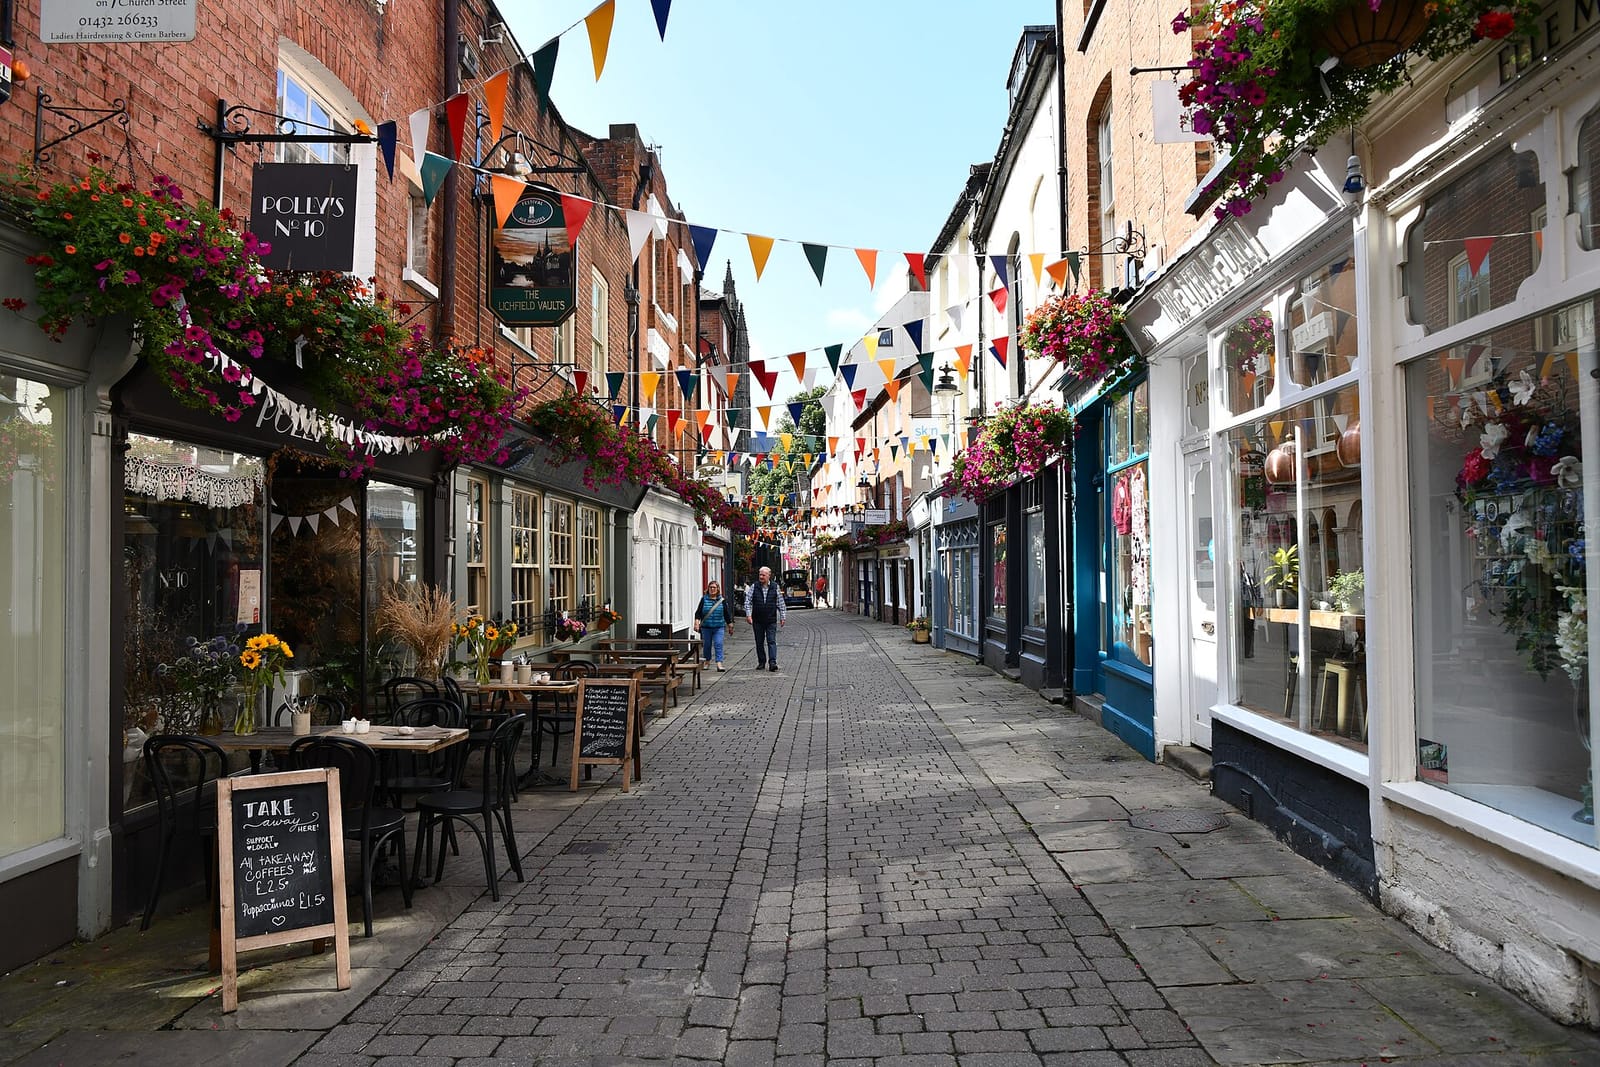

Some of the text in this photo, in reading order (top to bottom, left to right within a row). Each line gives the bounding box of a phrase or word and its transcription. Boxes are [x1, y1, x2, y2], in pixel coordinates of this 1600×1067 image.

[79, 13, 158, 29] 01432 266233
[50, 31, 187, 41] Ladies Hairdressing & Gents Barbers
[262, 196, 345, 218] POLLY'S
[304, 219, 325, 237] 10
[524, 290, 539, 299] THE
[498, 300, 565, 311] LICHFIELD VAULTS
[915, 425, 938, 437] skn
[177, 571, 189, 588] 10
[243, 799, 295, 818] TAKE
[297, 824, 319, 832] HERE!
[246, 836, 274, 844] SUPPORT
[252, 843, 275, 851] LOCAL
[239, 857, 253, 870] All
[245, 865, 294, 882] COFFEES
